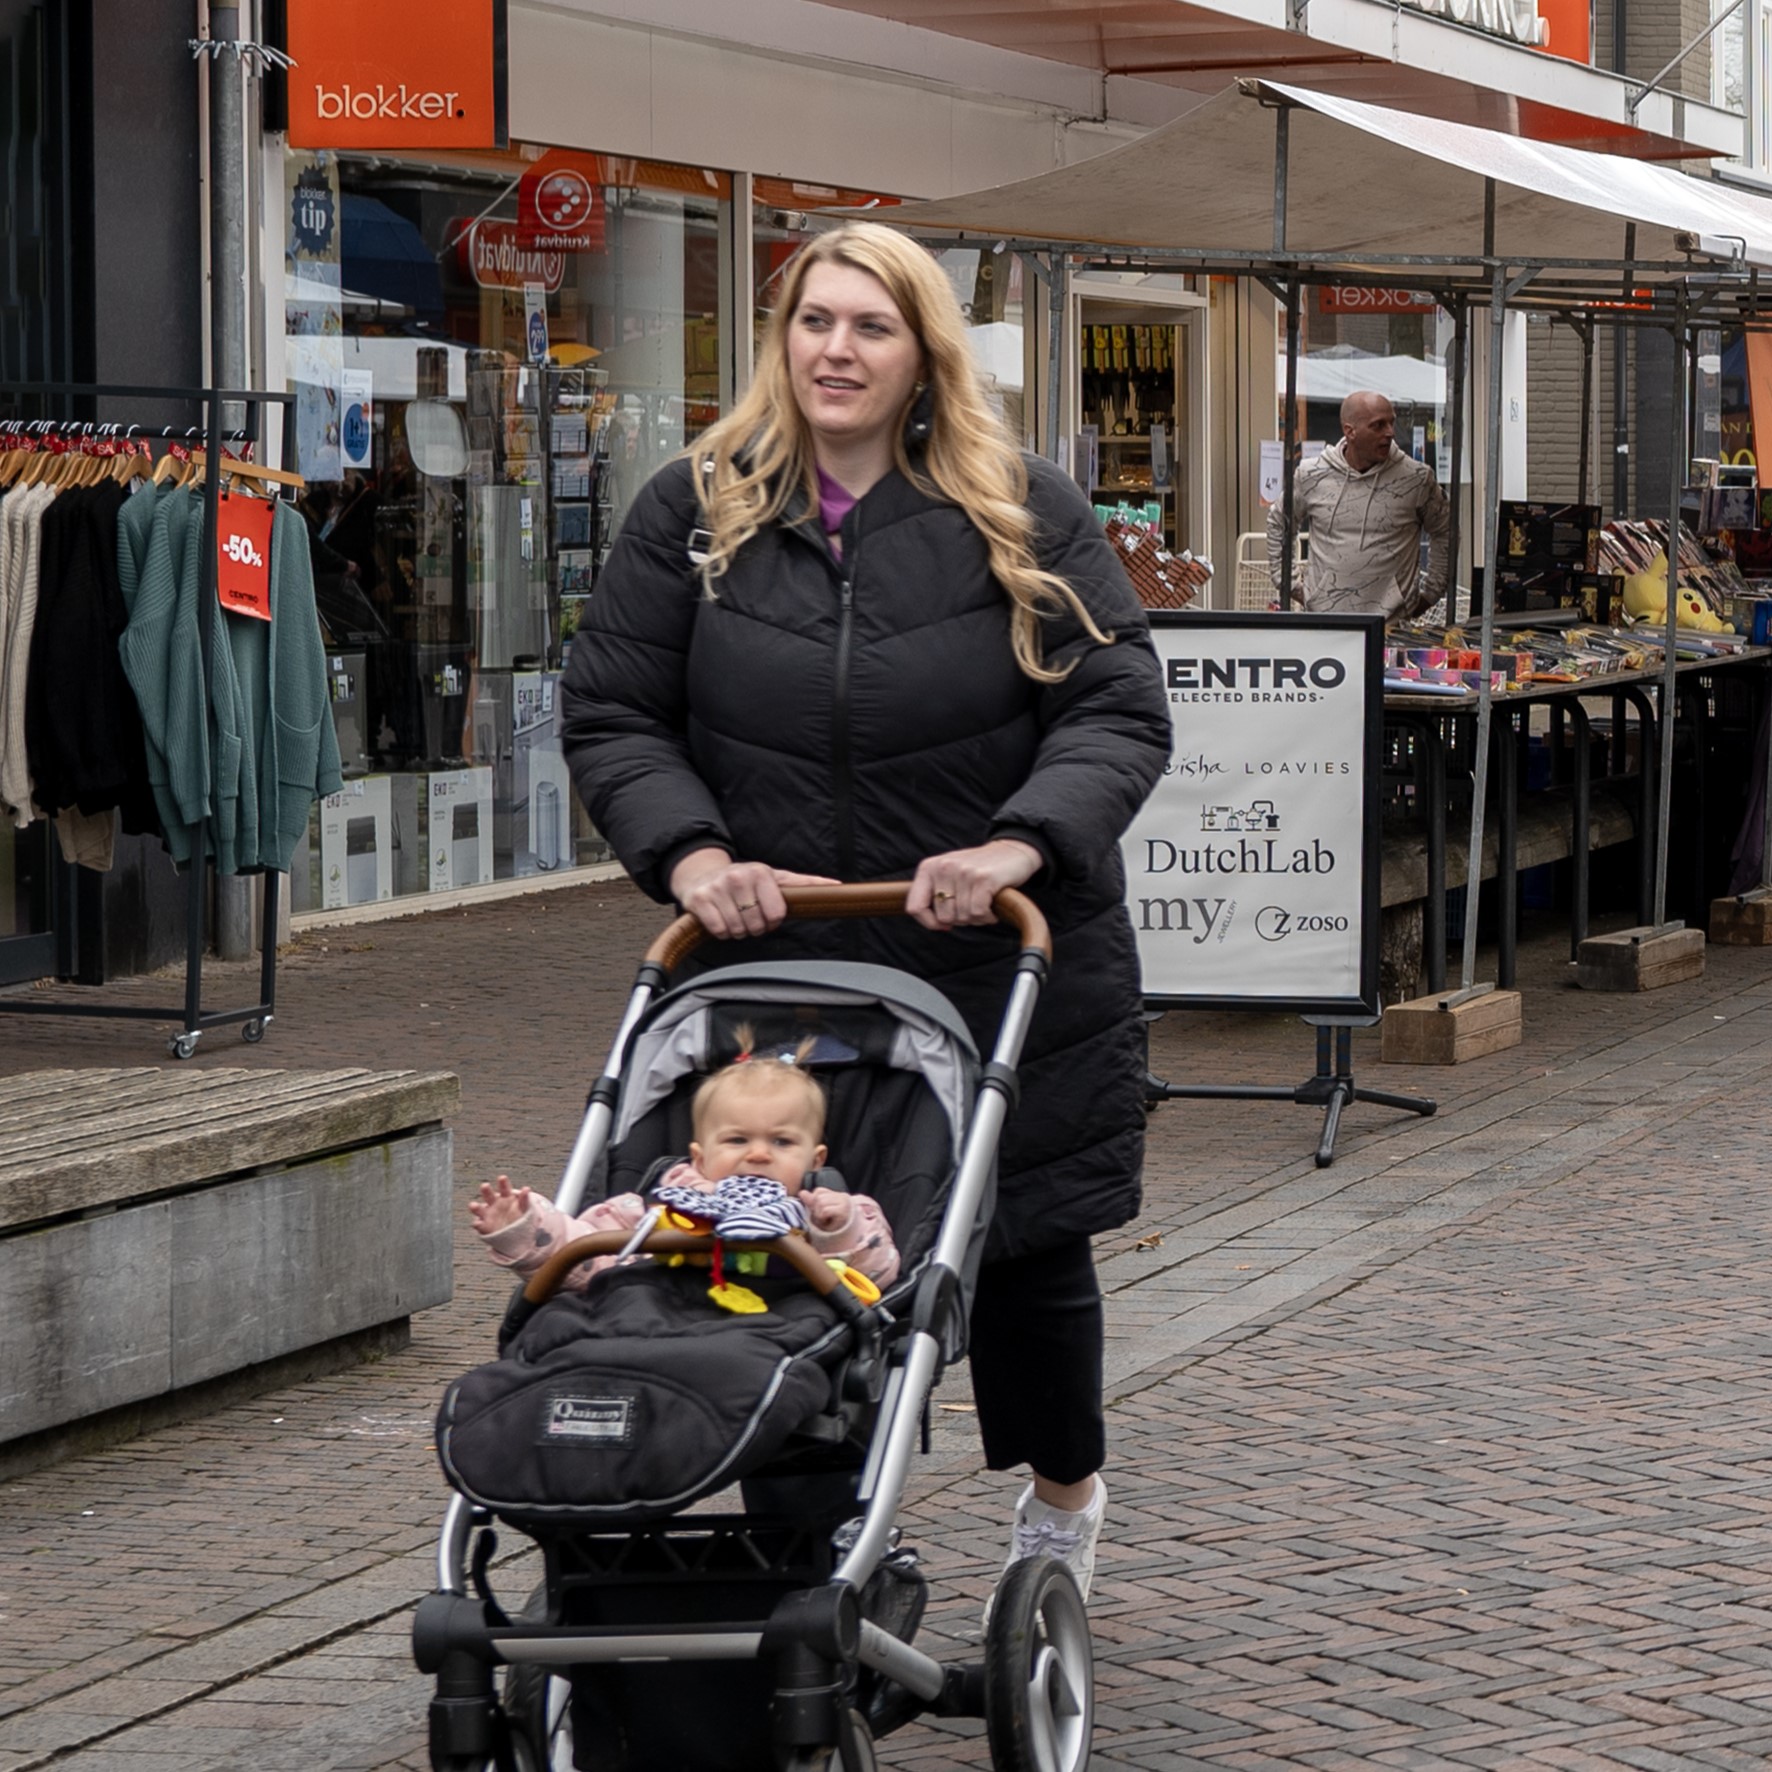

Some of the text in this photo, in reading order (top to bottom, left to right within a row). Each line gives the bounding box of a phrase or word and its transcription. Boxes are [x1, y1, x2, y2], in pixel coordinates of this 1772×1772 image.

[301, 201, 326, 236] tip
[222, 534, 262, 567] -50%
[229, 590, 259, 603] CENTRO
[1167, 657, 1346, 689] ENTRO
[1170, 692, 1244, 703] ELECTED
[1162, 752, 1350, 783] eisha LOAVIES
[1144, 839, 1335, 873] DutchLab
[1138, 898, 1226, 944] my
[1297, 915, 1348, 931] zoso
[554, 1402, 624, 1422] Quinny
